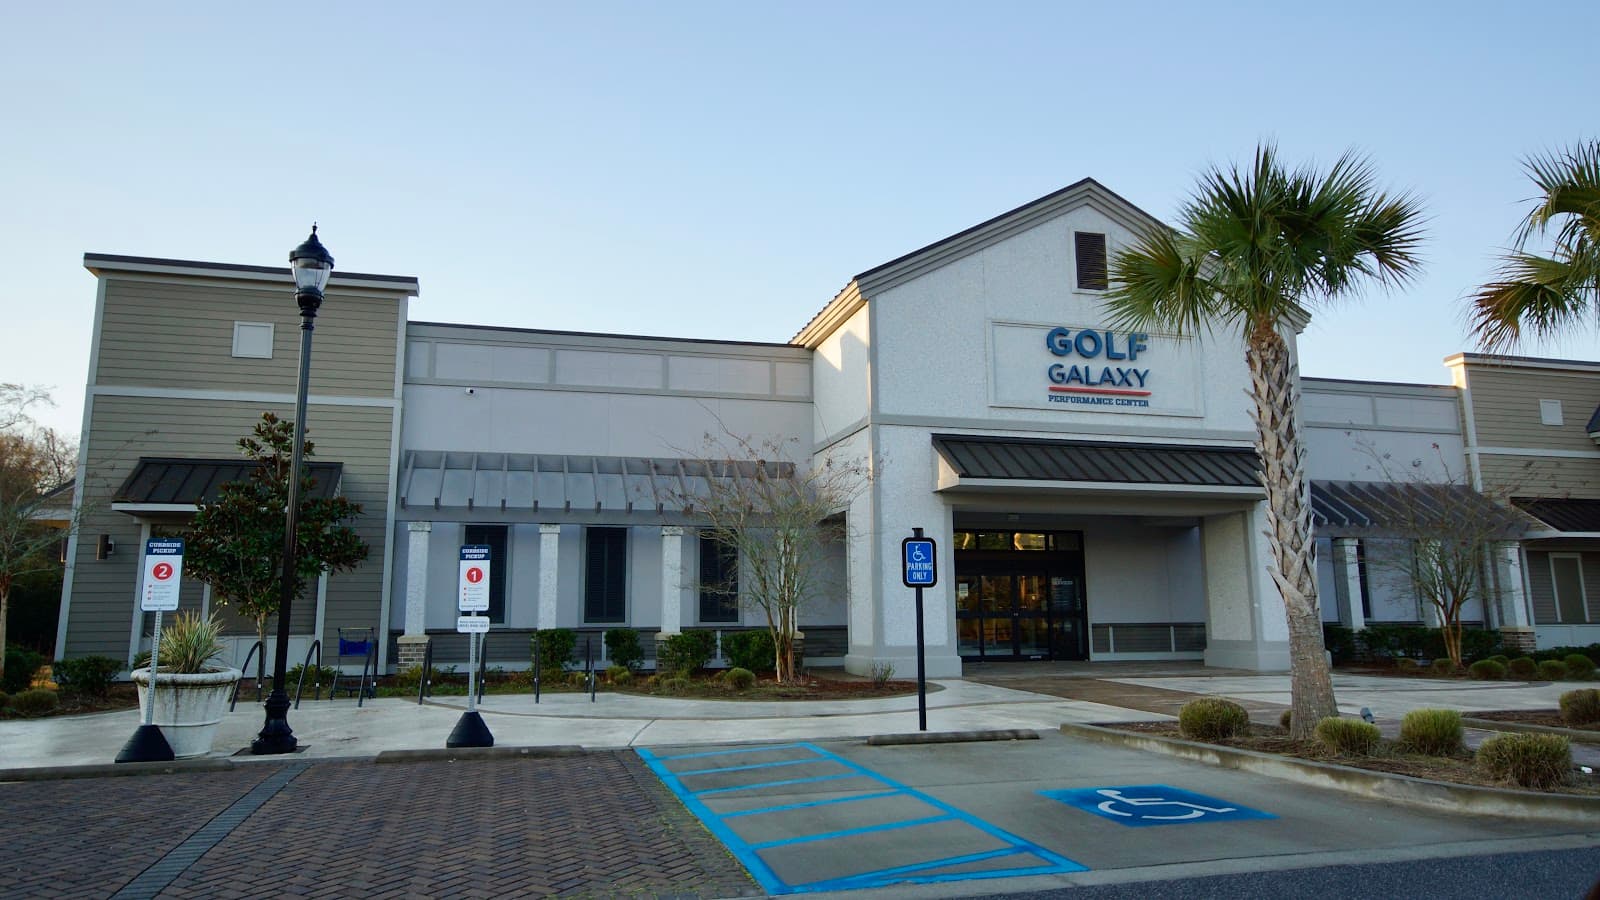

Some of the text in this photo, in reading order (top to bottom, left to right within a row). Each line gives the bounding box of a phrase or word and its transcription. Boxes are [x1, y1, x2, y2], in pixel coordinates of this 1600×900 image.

[1046, 327, 1149, 360] GOLF
[1048, 363, 1150, 388] GALAXY
[1048, 395, 1149, 408] PERFORMANCE CENTER
[158, 565, 168, 578] 2
[907, 562, 932, 570] PARKING
[471, 570, 477, 582] 1
[912, 572, 927, 580] ONLY
